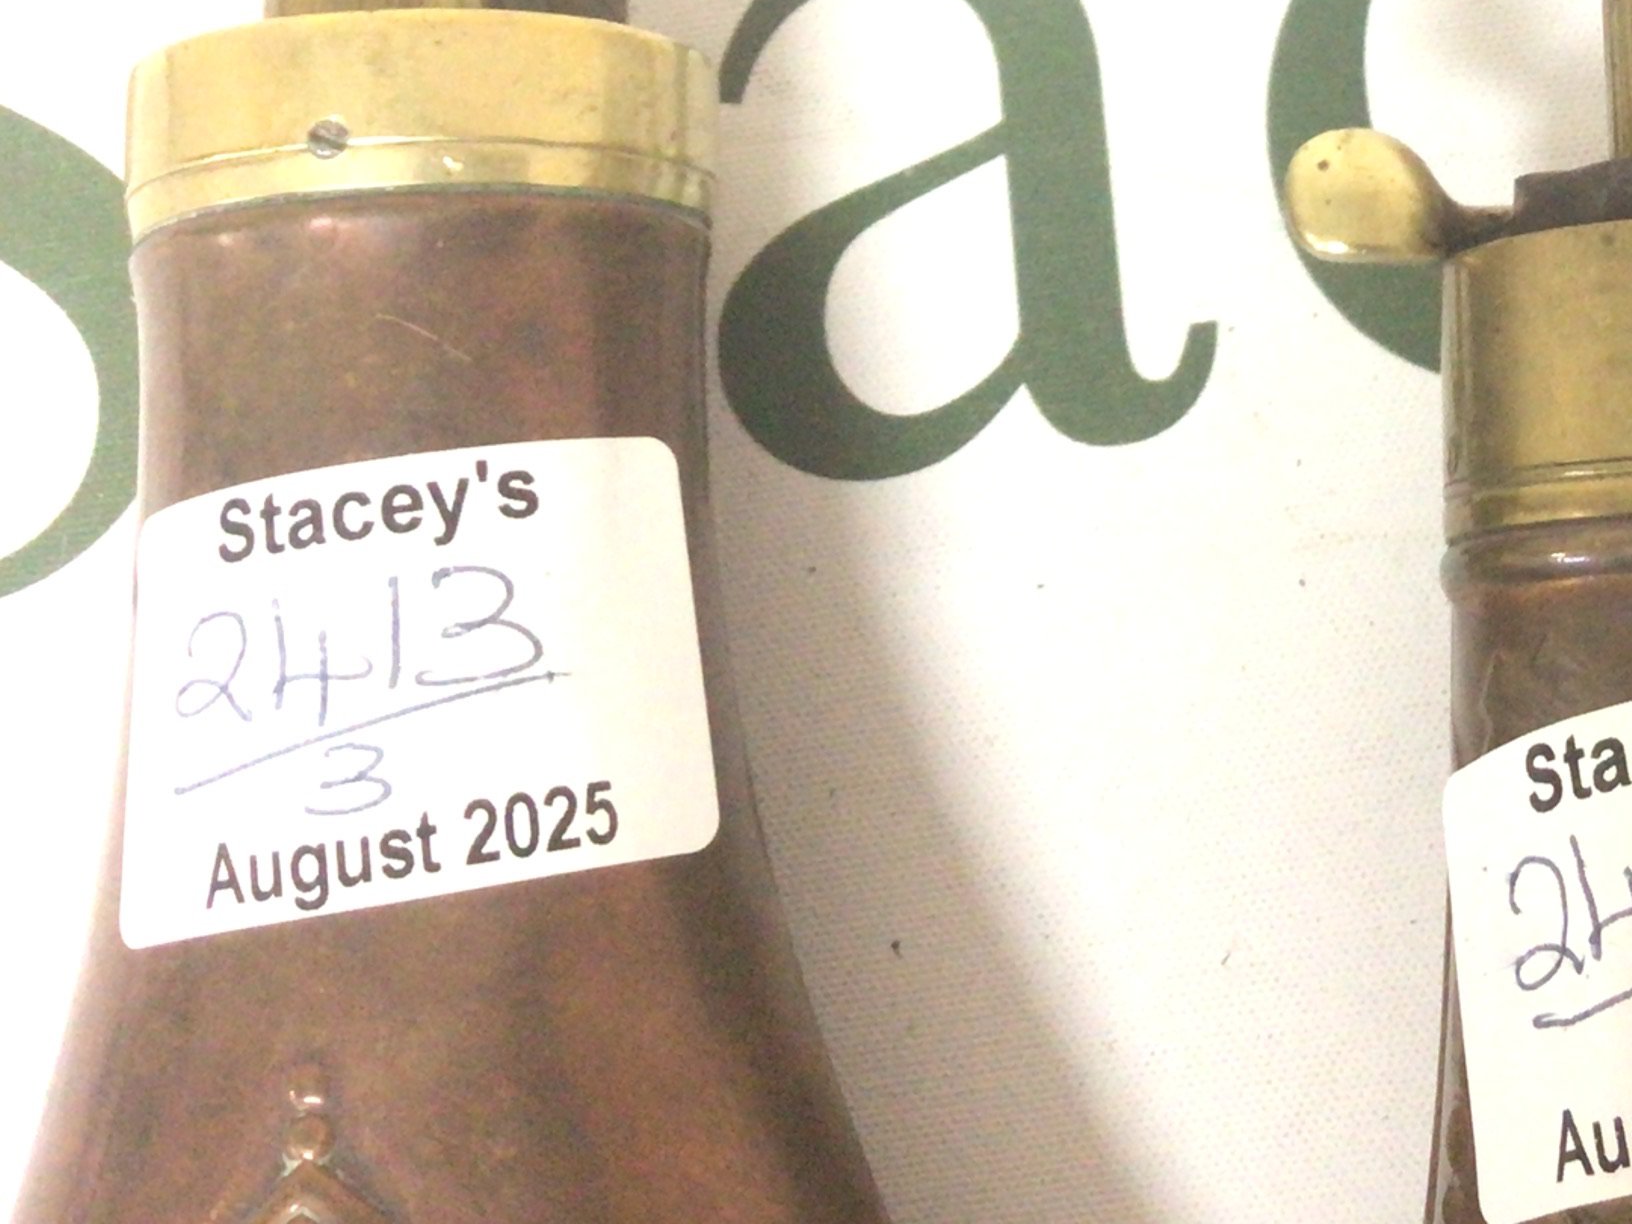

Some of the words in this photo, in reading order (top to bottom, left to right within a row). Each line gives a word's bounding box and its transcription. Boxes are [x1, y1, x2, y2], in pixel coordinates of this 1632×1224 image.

[218, 460, 539, 563] Stacey's
[175, 566, 543, 726] 2413
[304, 742, 393, 815] 3
[206, 812, 442, 911] August
[463, 780, 619, 866] 2025
